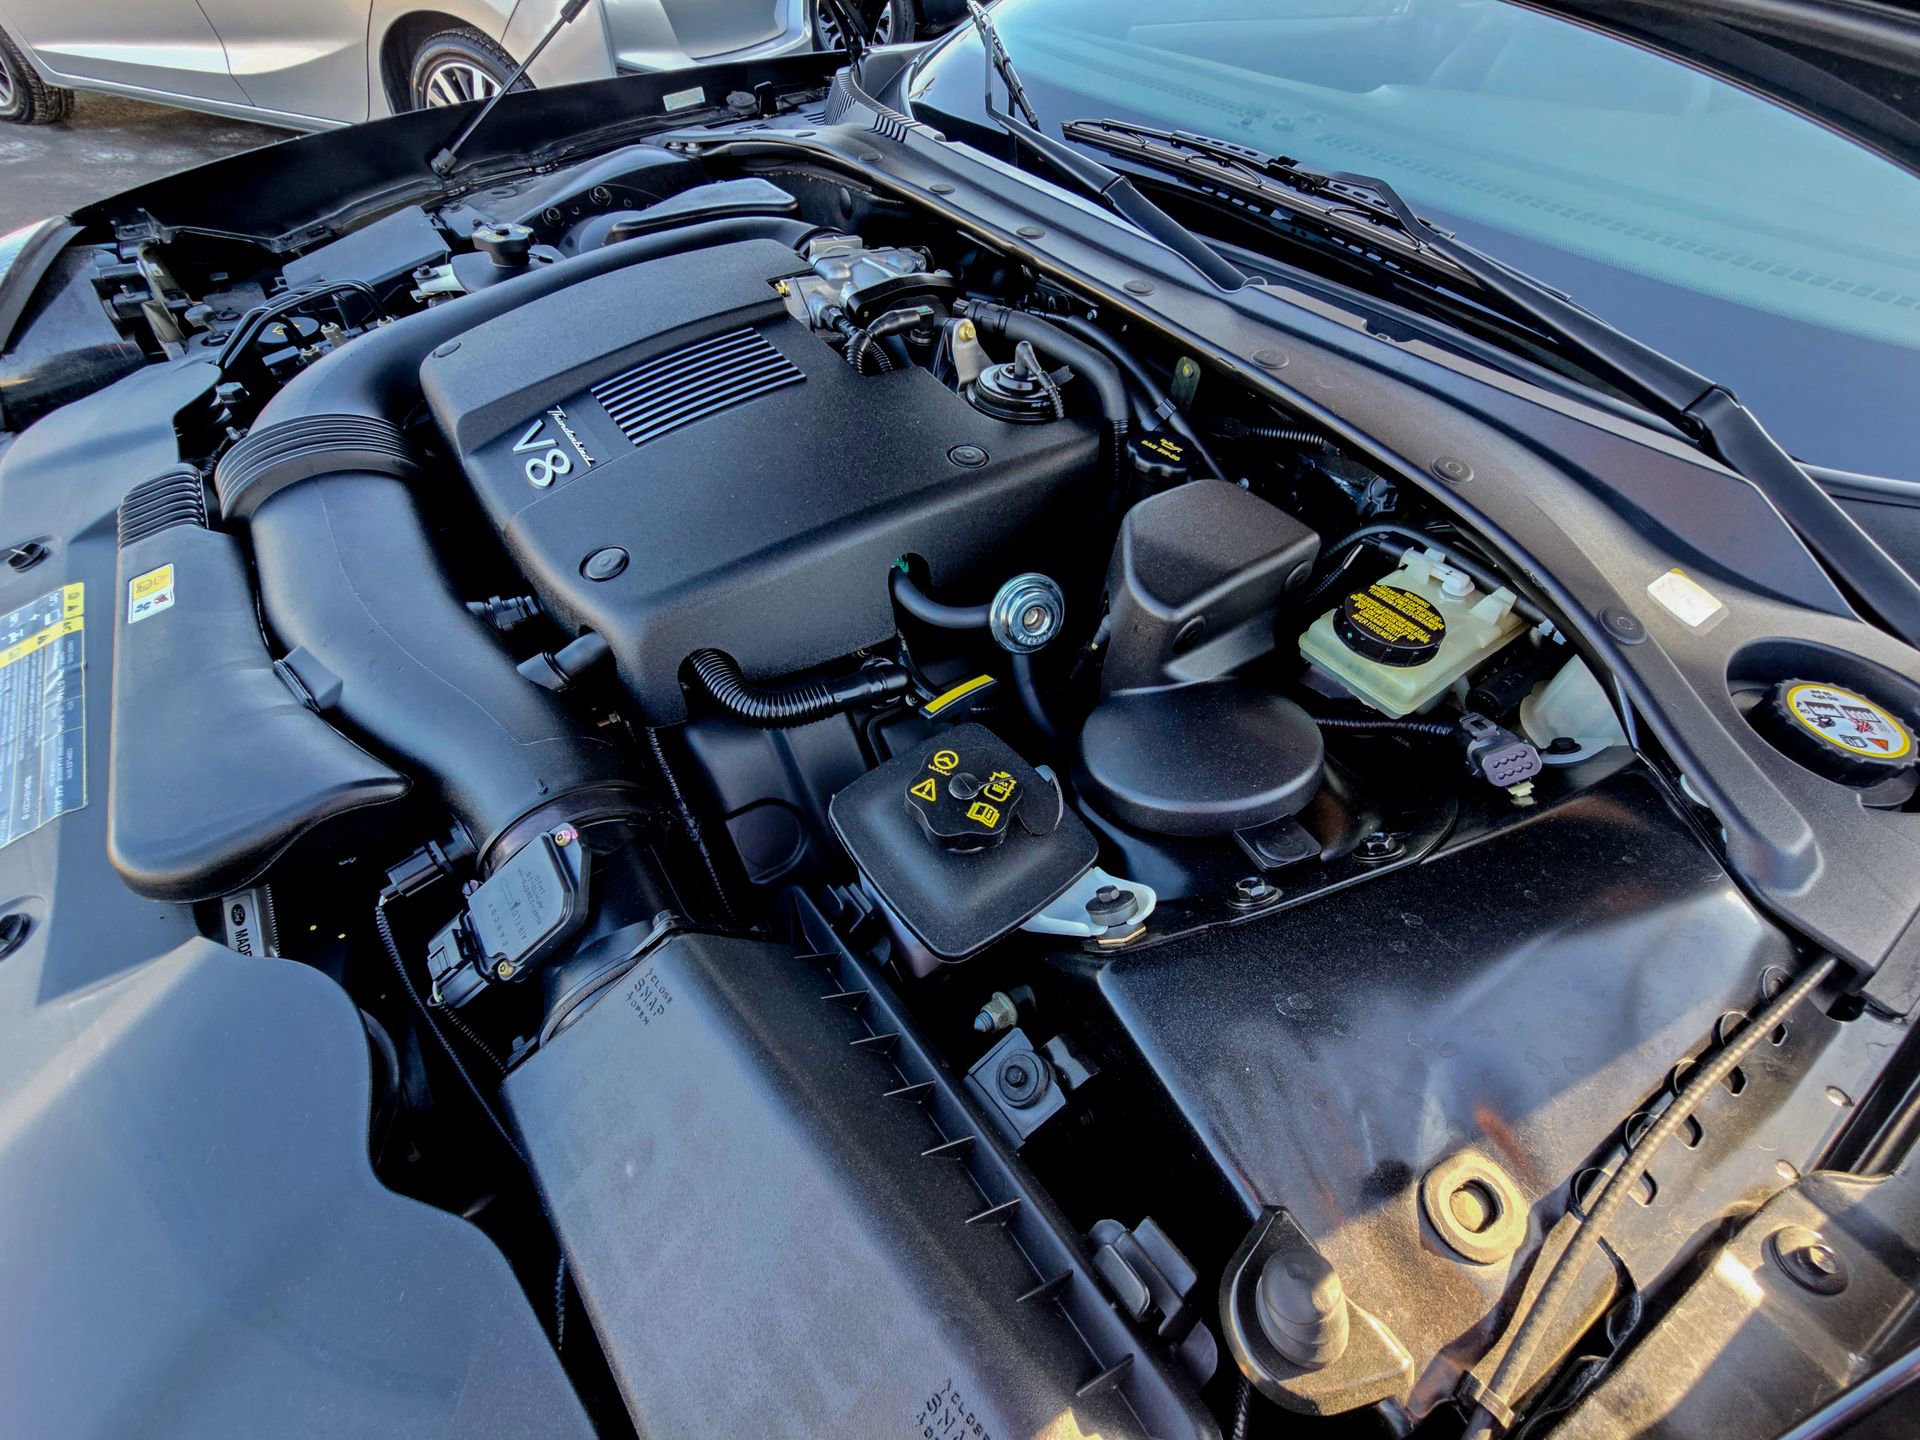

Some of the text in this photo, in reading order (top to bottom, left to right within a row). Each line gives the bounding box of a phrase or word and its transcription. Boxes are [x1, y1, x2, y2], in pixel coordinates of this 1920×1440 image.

[547, 404, 595, 468] Thunderbird
[512, 418, 572, 488] V8
[1404, 592, 1430, 608] WARNING
[1351, 612, 1397, 643] AVERTISSEMENT
[634, 978, 665, 1016] SNAP
[650, 975, 673, 1006] CLOSE
[630, 1000, 650, 1025] OPEN
